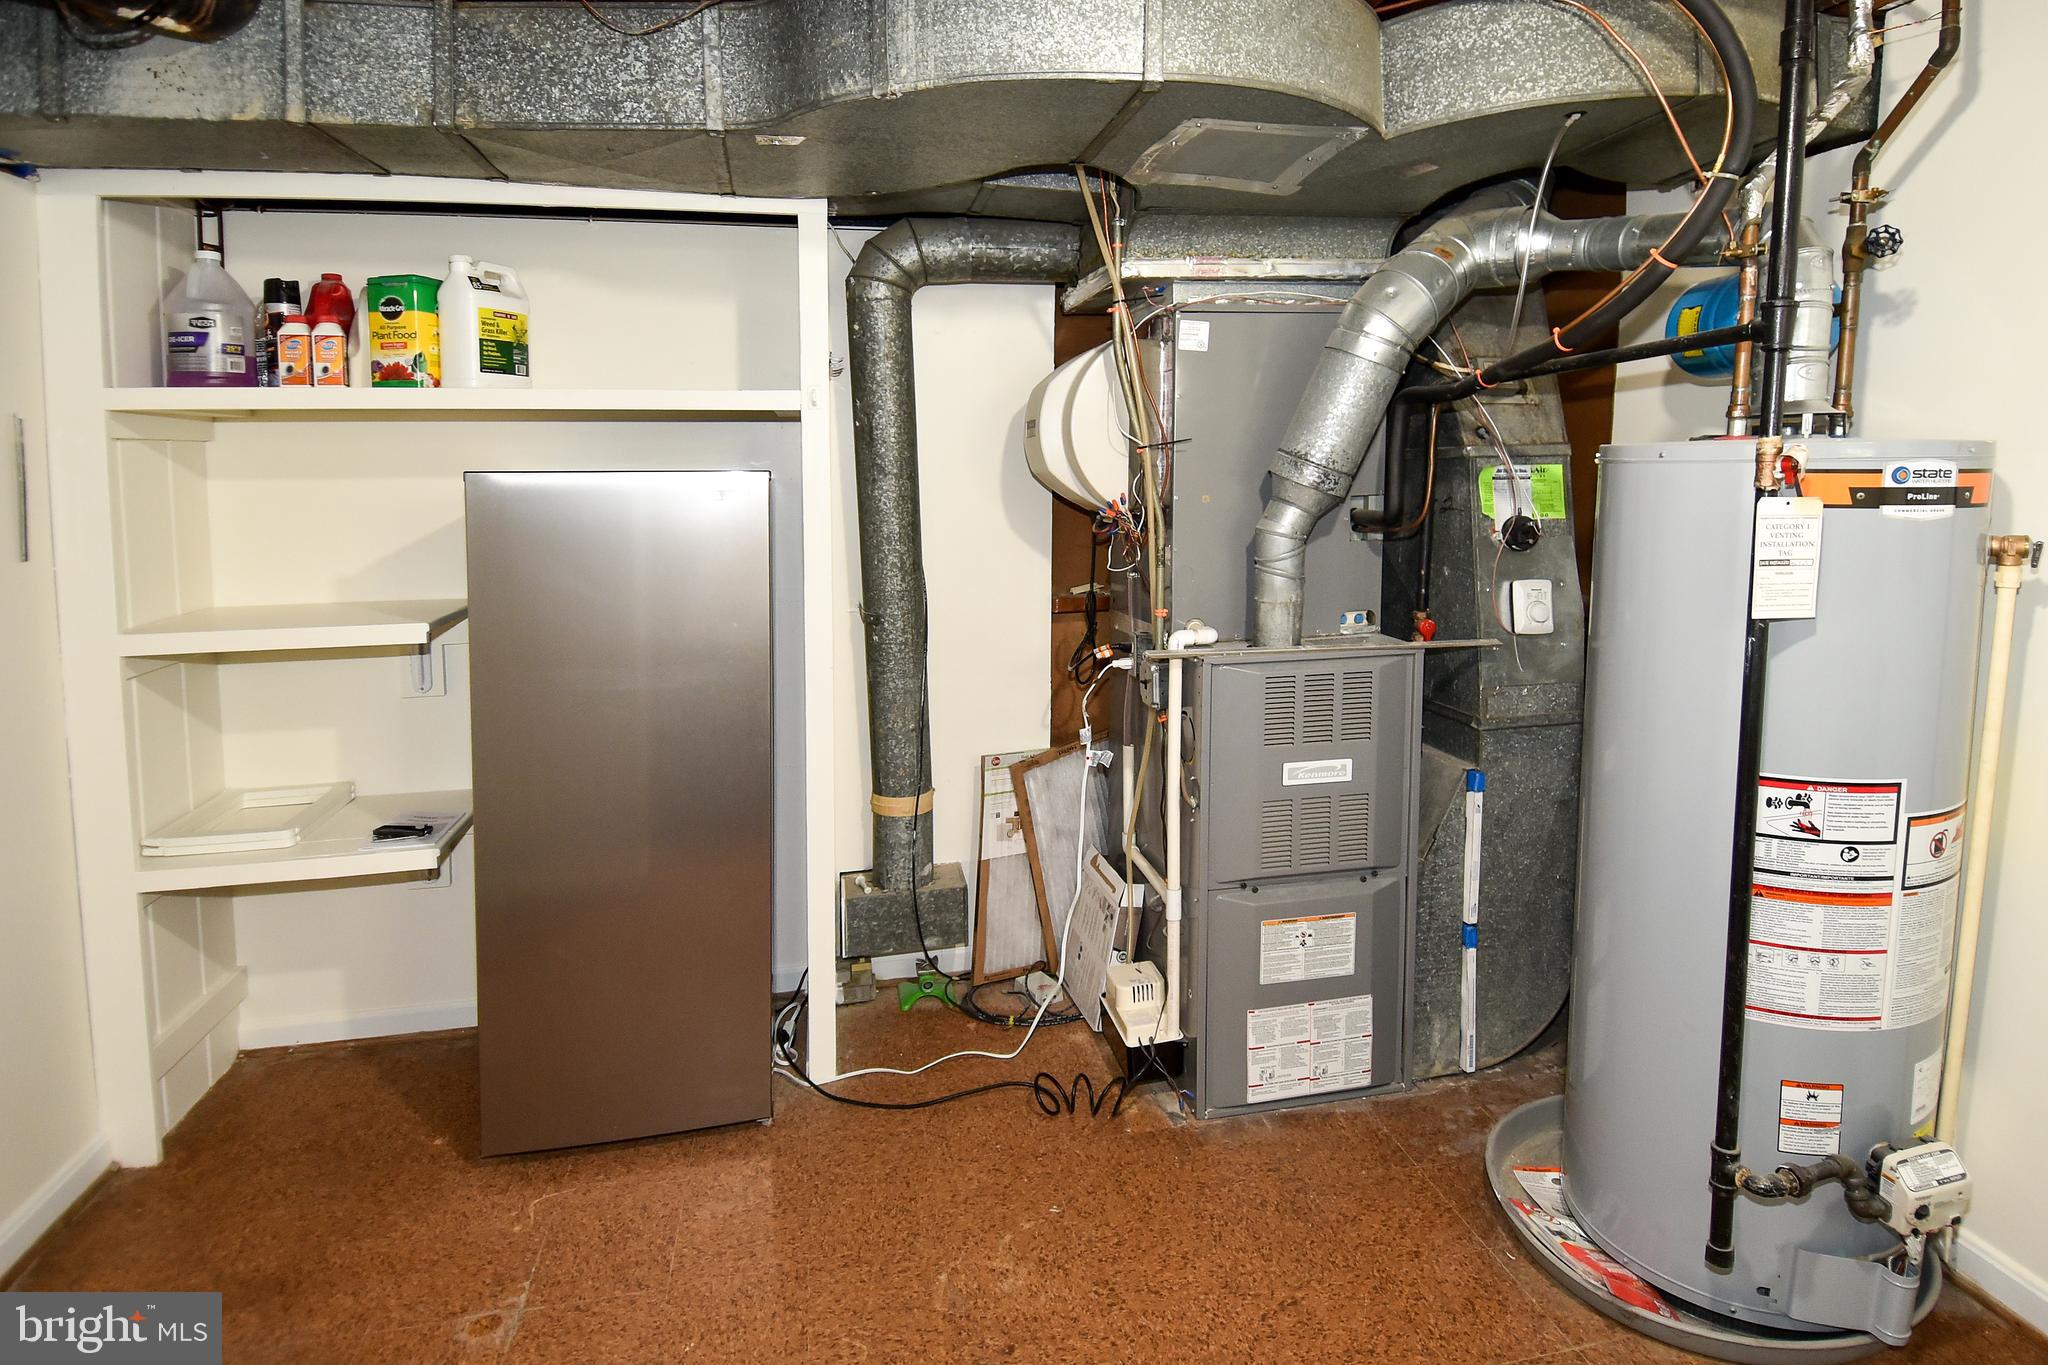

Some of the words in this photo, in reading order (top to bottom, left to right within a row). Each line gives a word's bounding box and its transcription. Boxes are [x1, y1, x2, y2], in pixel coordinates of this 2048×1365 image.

[481, 320, 496, 328] Weed
[372, 331, 392, 341] Plant
[393, 330, 417, 340] Food
[481, 326, 496, 335] Grass
[496, 328, 508, 336] Killer
[1912, 468, 1953, 479] state
[1907, 492, 1938, 501] ProLine
[1765, 523, 1804, 531] CATEGORY
[1297, 769, 1346, 780] Kenmore
